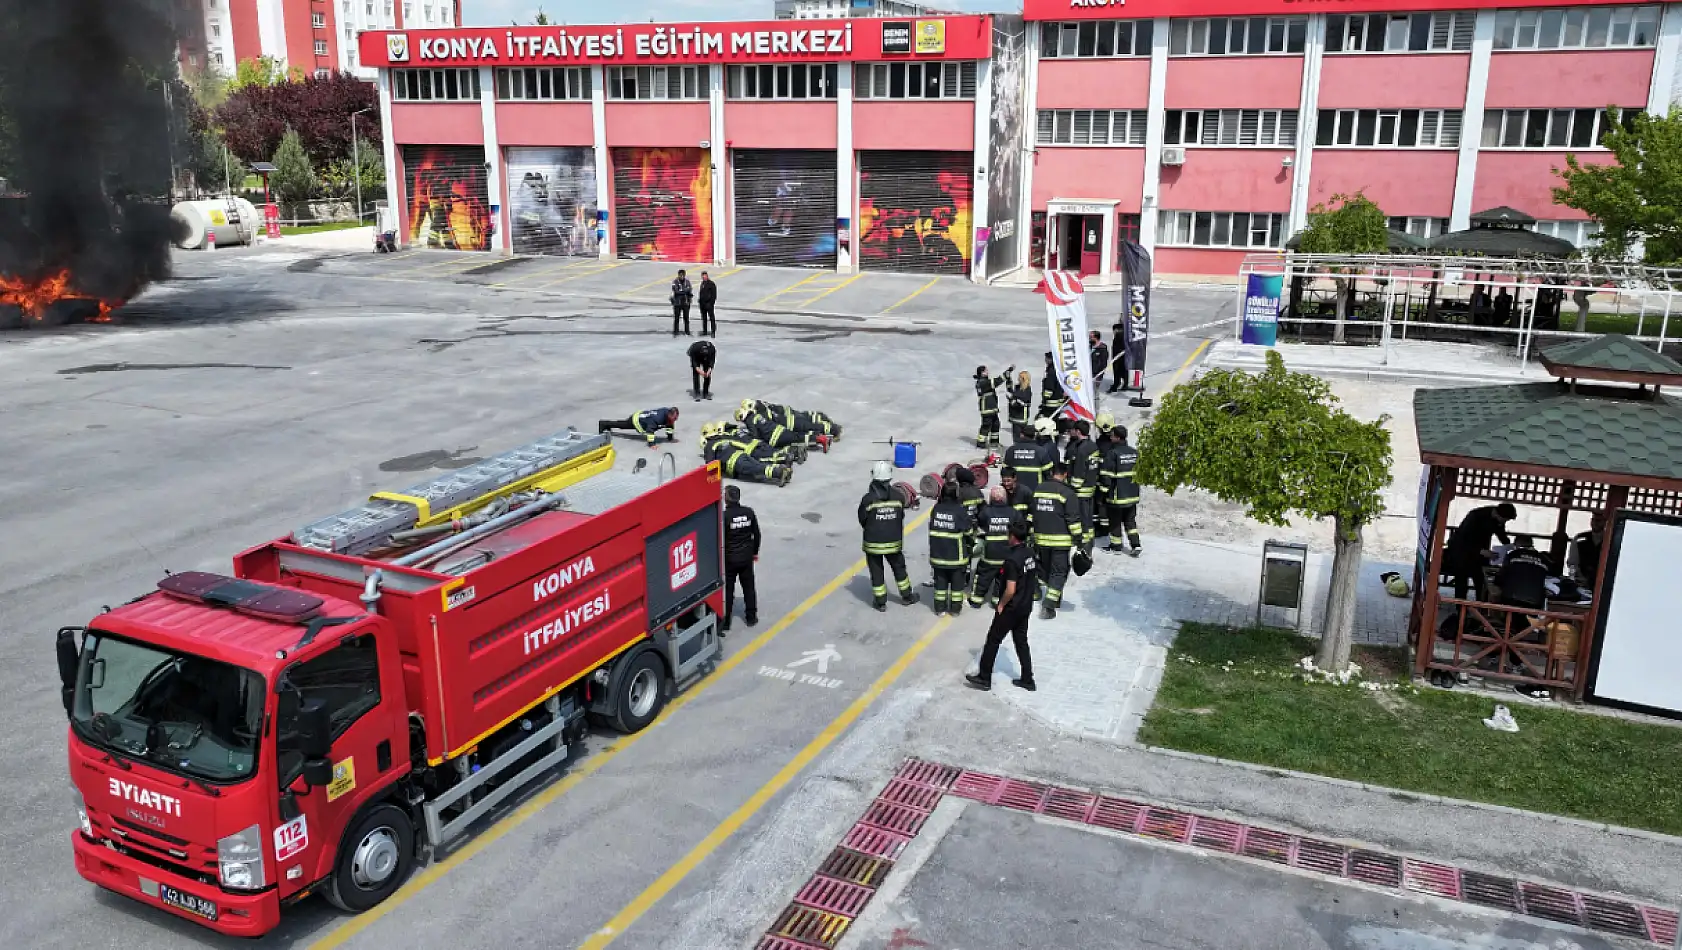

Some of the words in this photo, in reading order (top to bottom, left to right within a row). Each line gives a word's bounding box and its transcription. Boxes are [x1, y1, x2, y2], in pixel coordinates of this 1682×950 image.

[419, 38, 498, 59] KONYA
[506, 28, 624, 58] İTFAİYESİ
[635, 27, 723, 55] EĞİTİM
[731, 22, 852, 54] MERKEZİ
[674, 539, 694, 569] 112
[533, 556, 595, 602] KONYA
[523, 588, 610, 655] İTFAİYESİ
[127, 807, 166, 828] ISUZU
[279, 822, 302, 846] 112
[167, 889, 178, 903] 42
